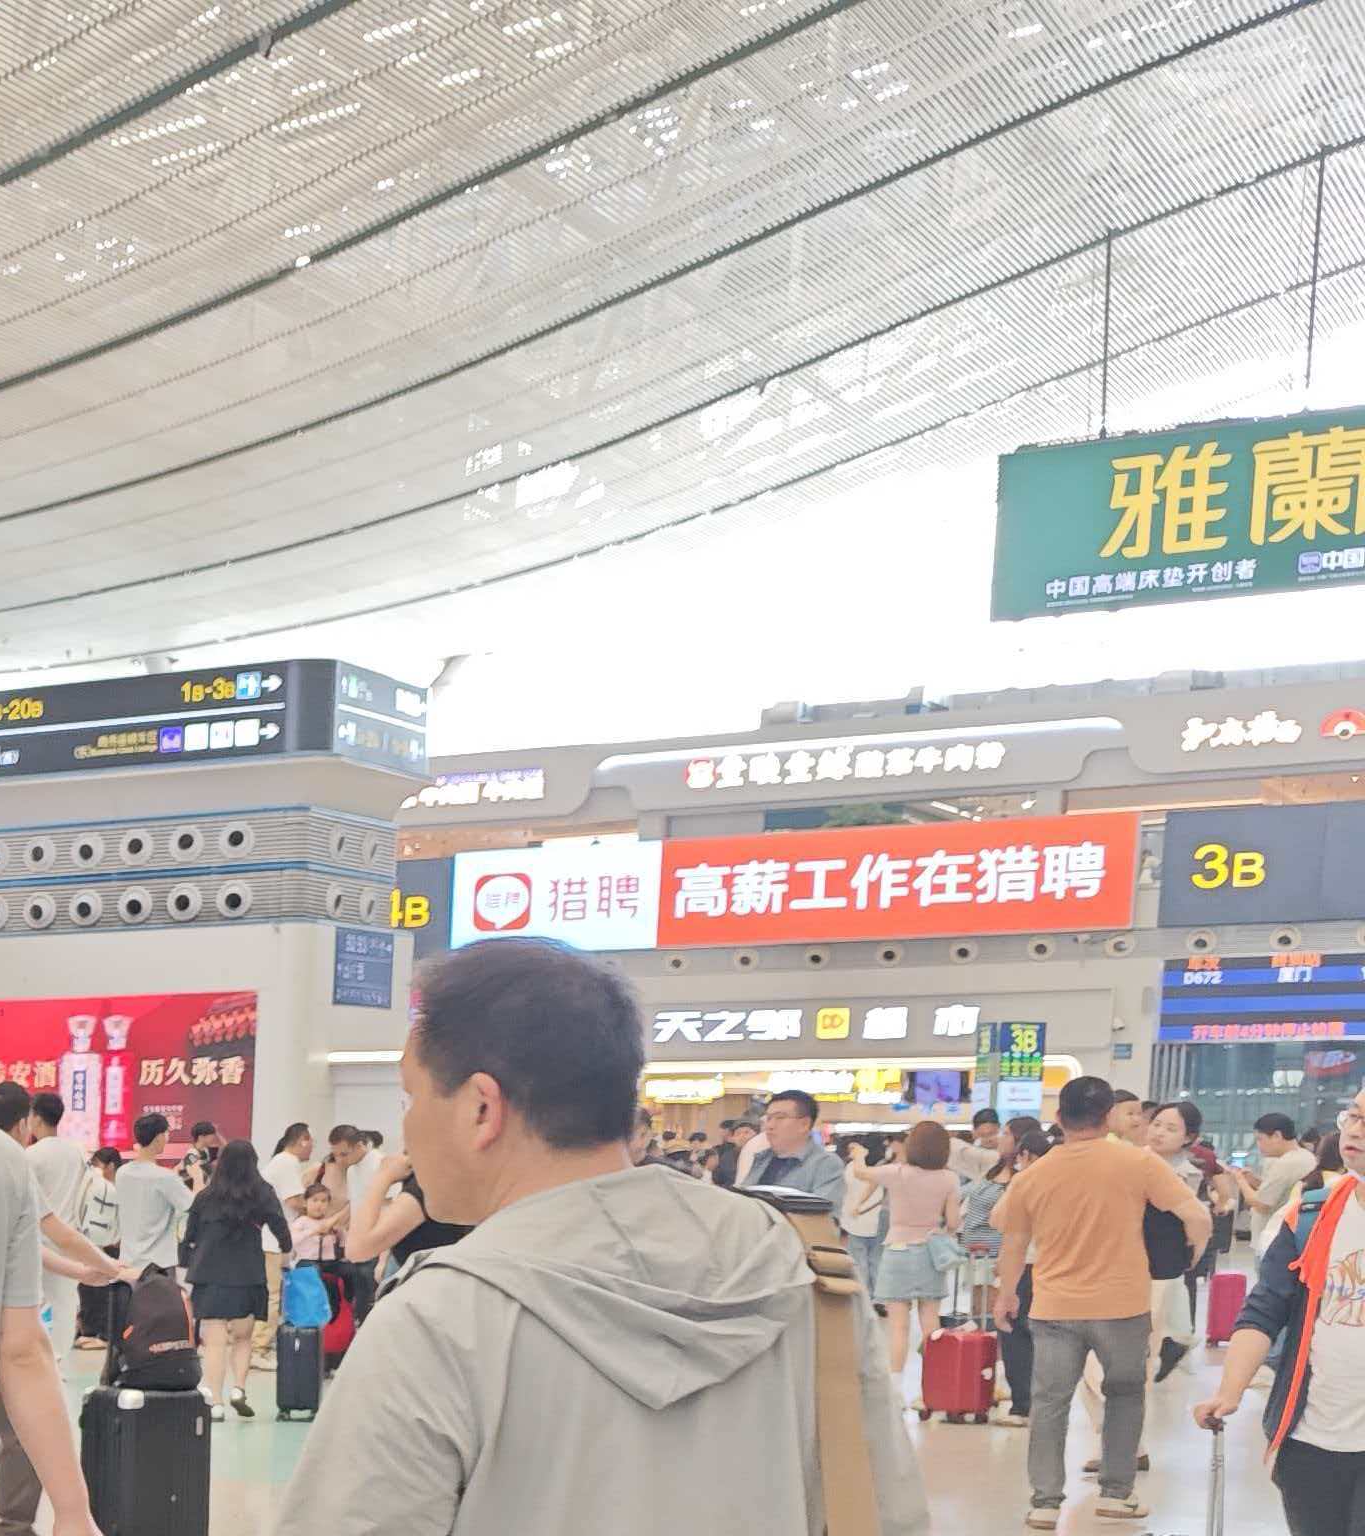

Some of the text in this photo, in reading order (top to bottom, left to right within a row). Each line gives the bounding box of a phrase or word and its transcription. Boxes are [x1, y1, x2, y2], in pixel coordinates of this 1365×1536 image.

[1098, 426, 1365, 559] 雅蘭
[1045, 557, 1257, 600] 中国高端床垫开创者
[673, 840, 1106, 920] 高薪工作在猎聘
[1190, 842, 1268, 891] 3B
[548, 875, 640, 922] 猎聘
[1010, 1028, 1038, 1054] 3B
[138, 1055, 246, 1087] 历久弥香
